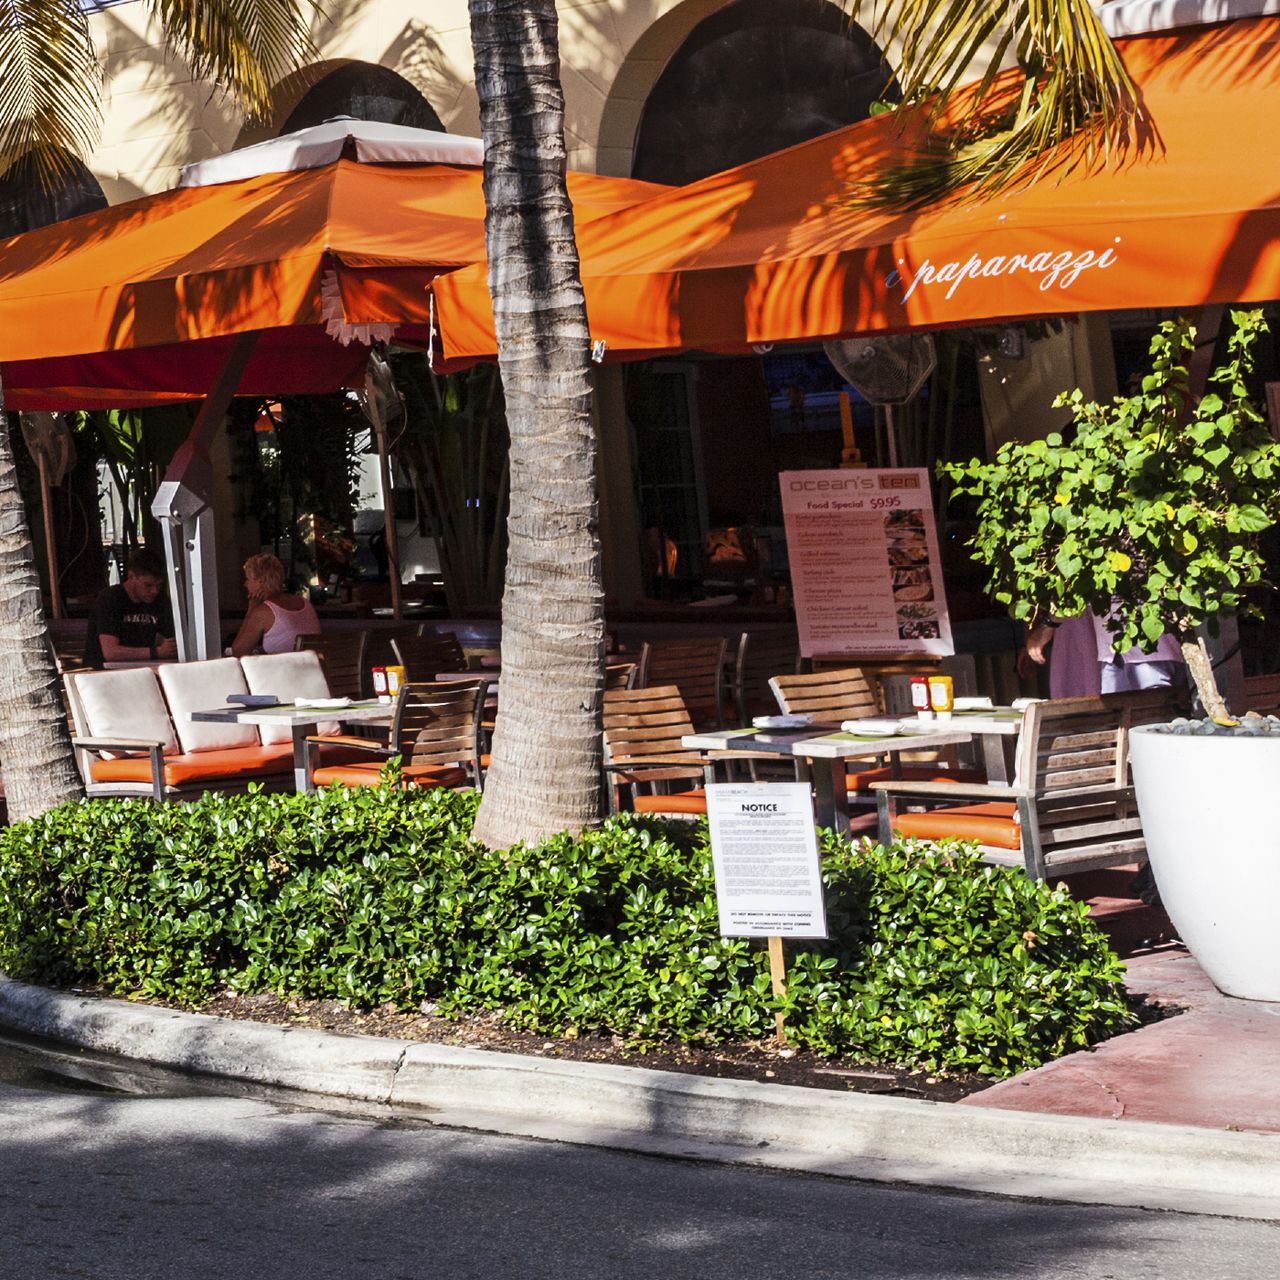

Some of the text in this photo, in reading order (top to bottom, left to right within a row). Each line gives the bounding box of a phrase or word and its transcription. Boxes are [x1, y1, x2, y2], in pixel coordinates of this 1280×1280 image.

[900, 236, 1122, 305] paparazzi
[790, 474, 920, 492] ocean's ten
[807, 496, 901, 511] Food Special $9.95
[741, 803, 778, 812] NOTICE
